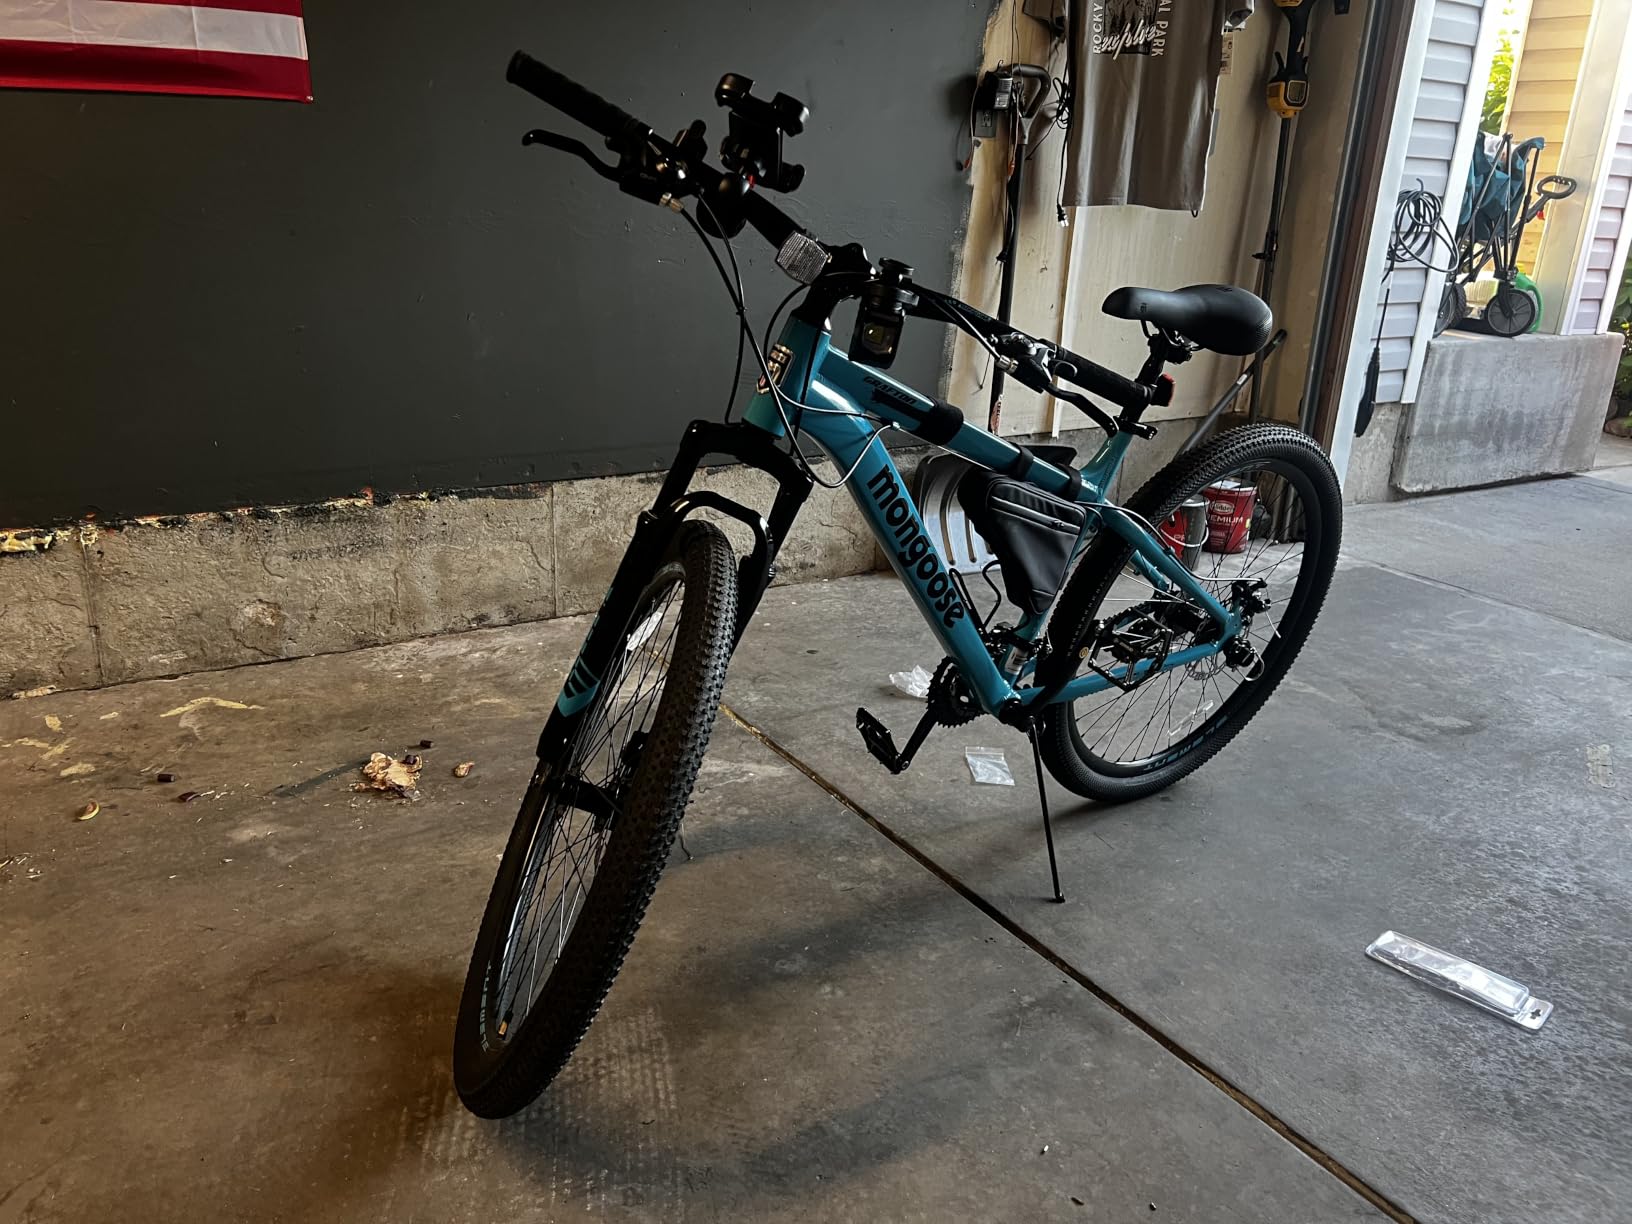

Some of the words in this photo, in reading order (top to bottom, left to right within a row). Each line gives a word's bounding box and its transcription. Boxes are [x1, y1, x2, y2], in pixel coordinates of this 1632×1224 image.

[1092, 2, 1103, 54] ROCKY
[1151, 20, 1169, 57] PARK
[866, 463, 965, 629] mongoose
